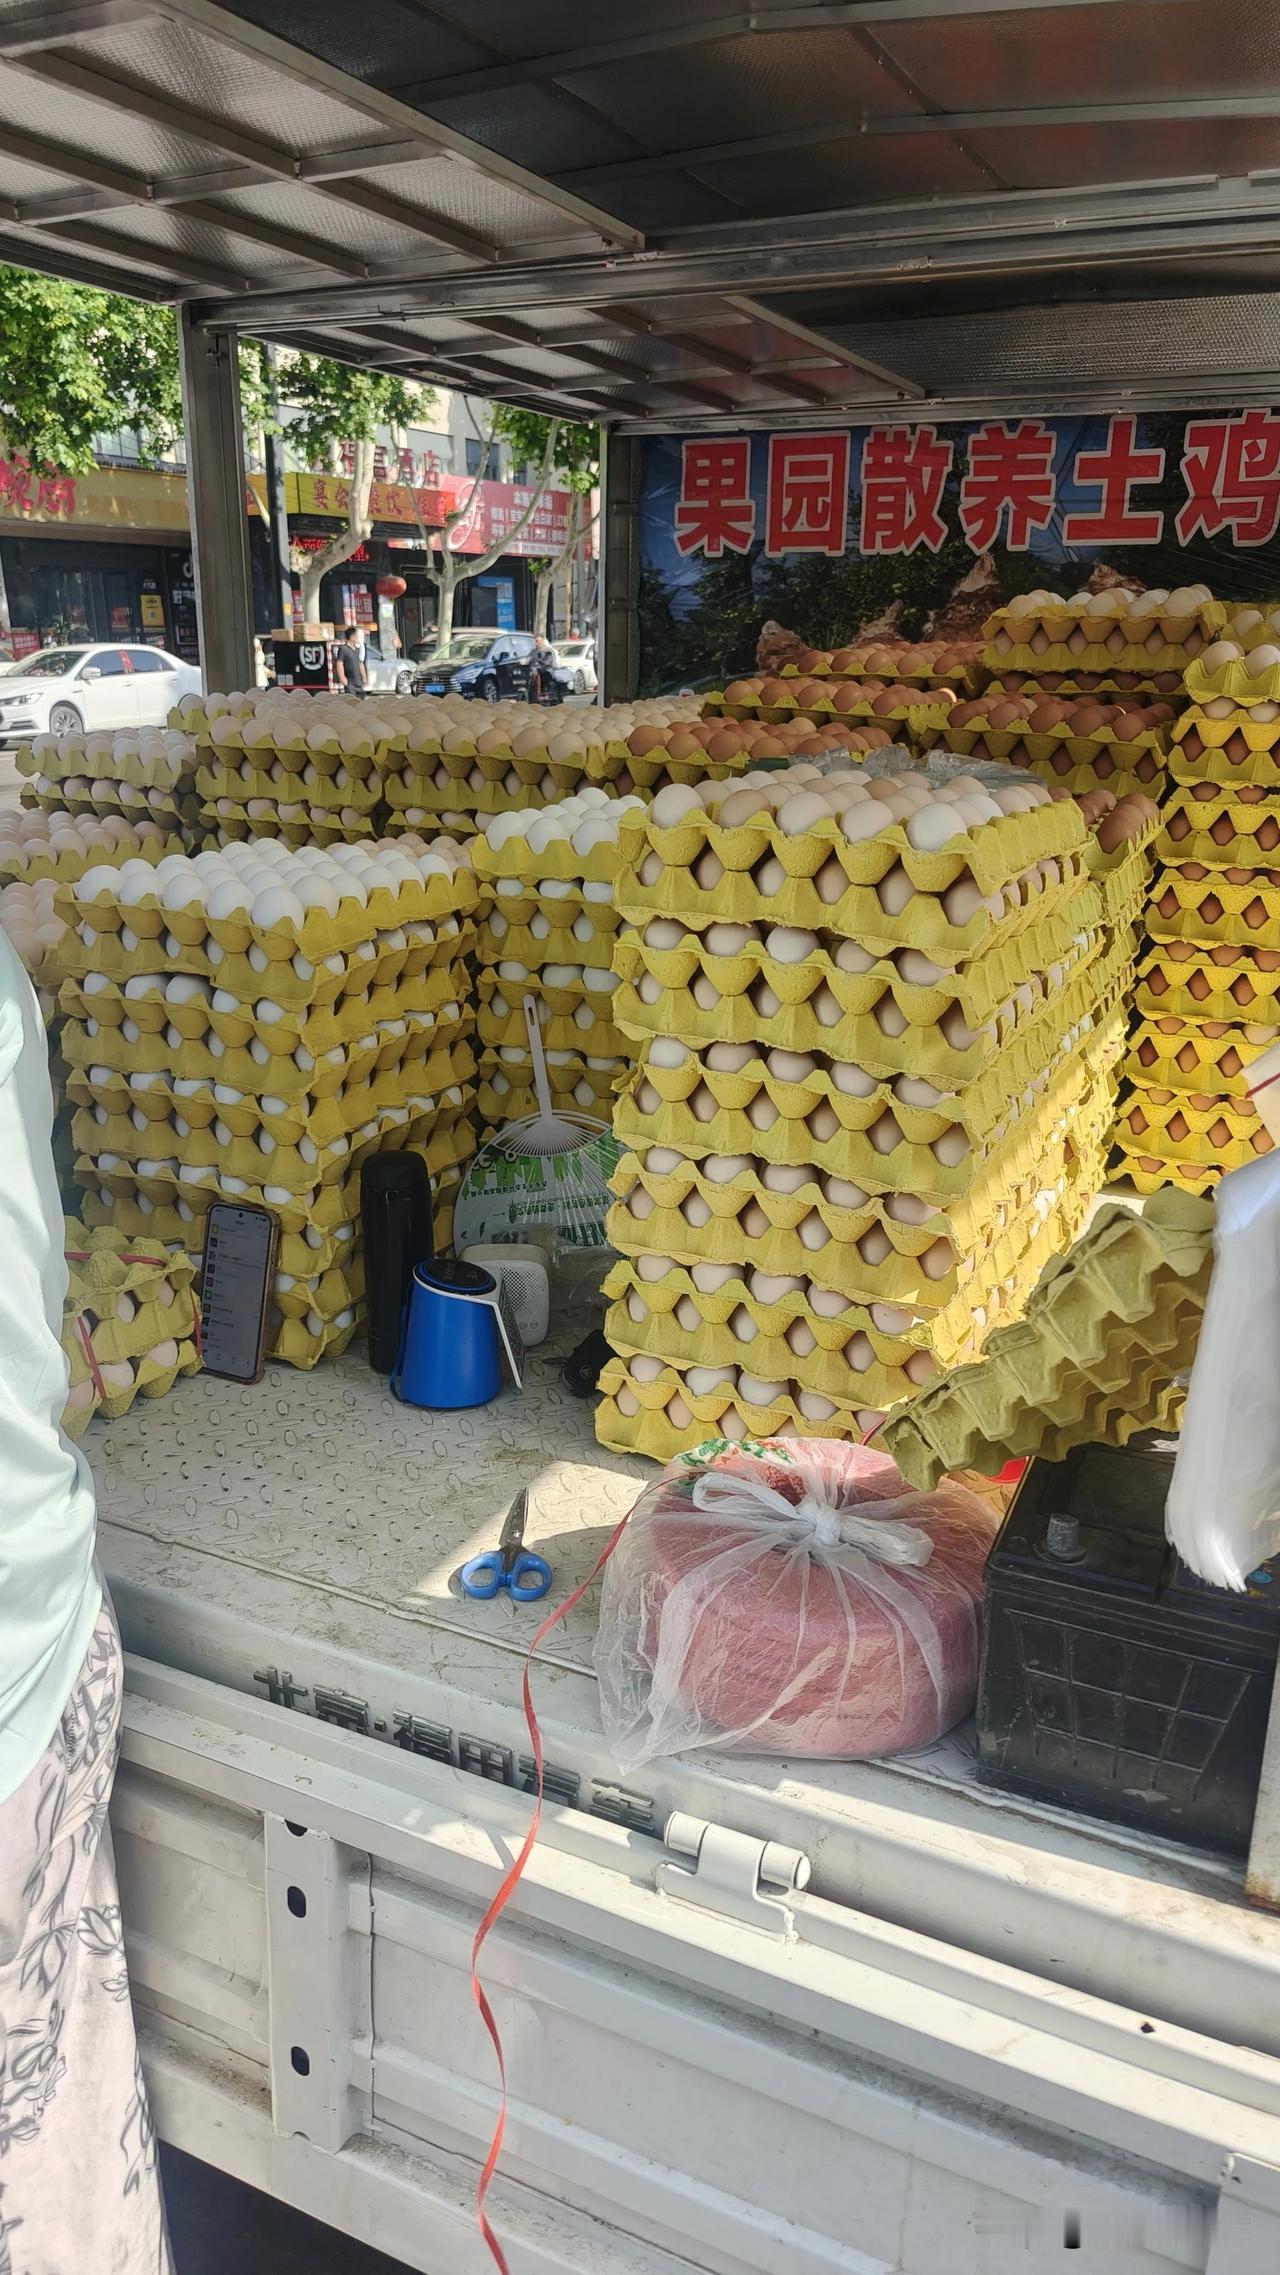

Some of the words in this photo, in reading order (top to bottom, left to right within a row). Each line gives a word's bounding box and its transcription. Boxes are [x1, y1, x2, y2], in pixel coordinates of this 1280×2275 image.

[673, 407, 1280, 558] 果园散养土鸡
